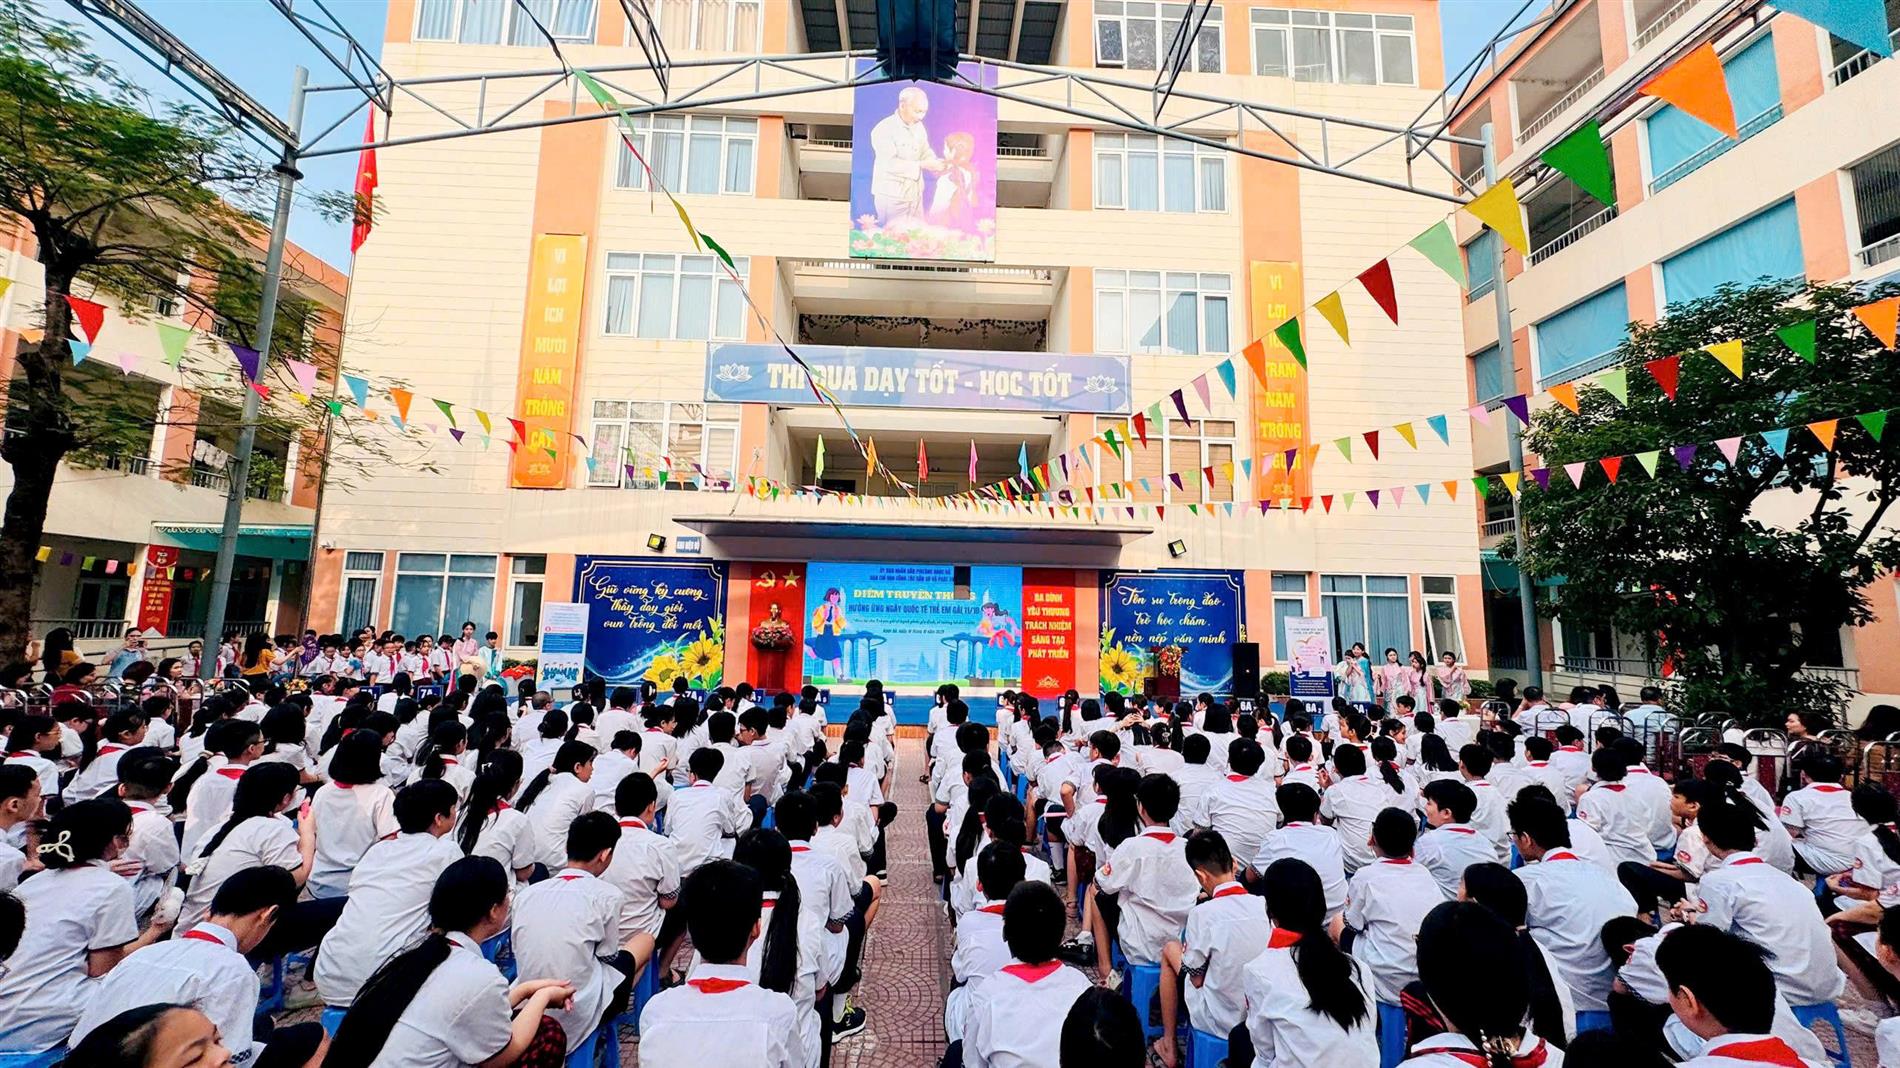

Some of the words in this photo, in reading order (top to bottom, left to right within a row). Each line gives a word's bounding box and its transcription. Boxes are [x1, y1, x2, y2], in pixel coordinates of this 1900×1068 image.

[767, 363, 806, 389] THI
[863, 366, 910, 397] DẠY
[915, 359, 959, 394] TỐT
[962, 380, 974, 388] -
[979, 369, 1023, 401] HỌC
[1029, 363, 1073, 398] TỐT
